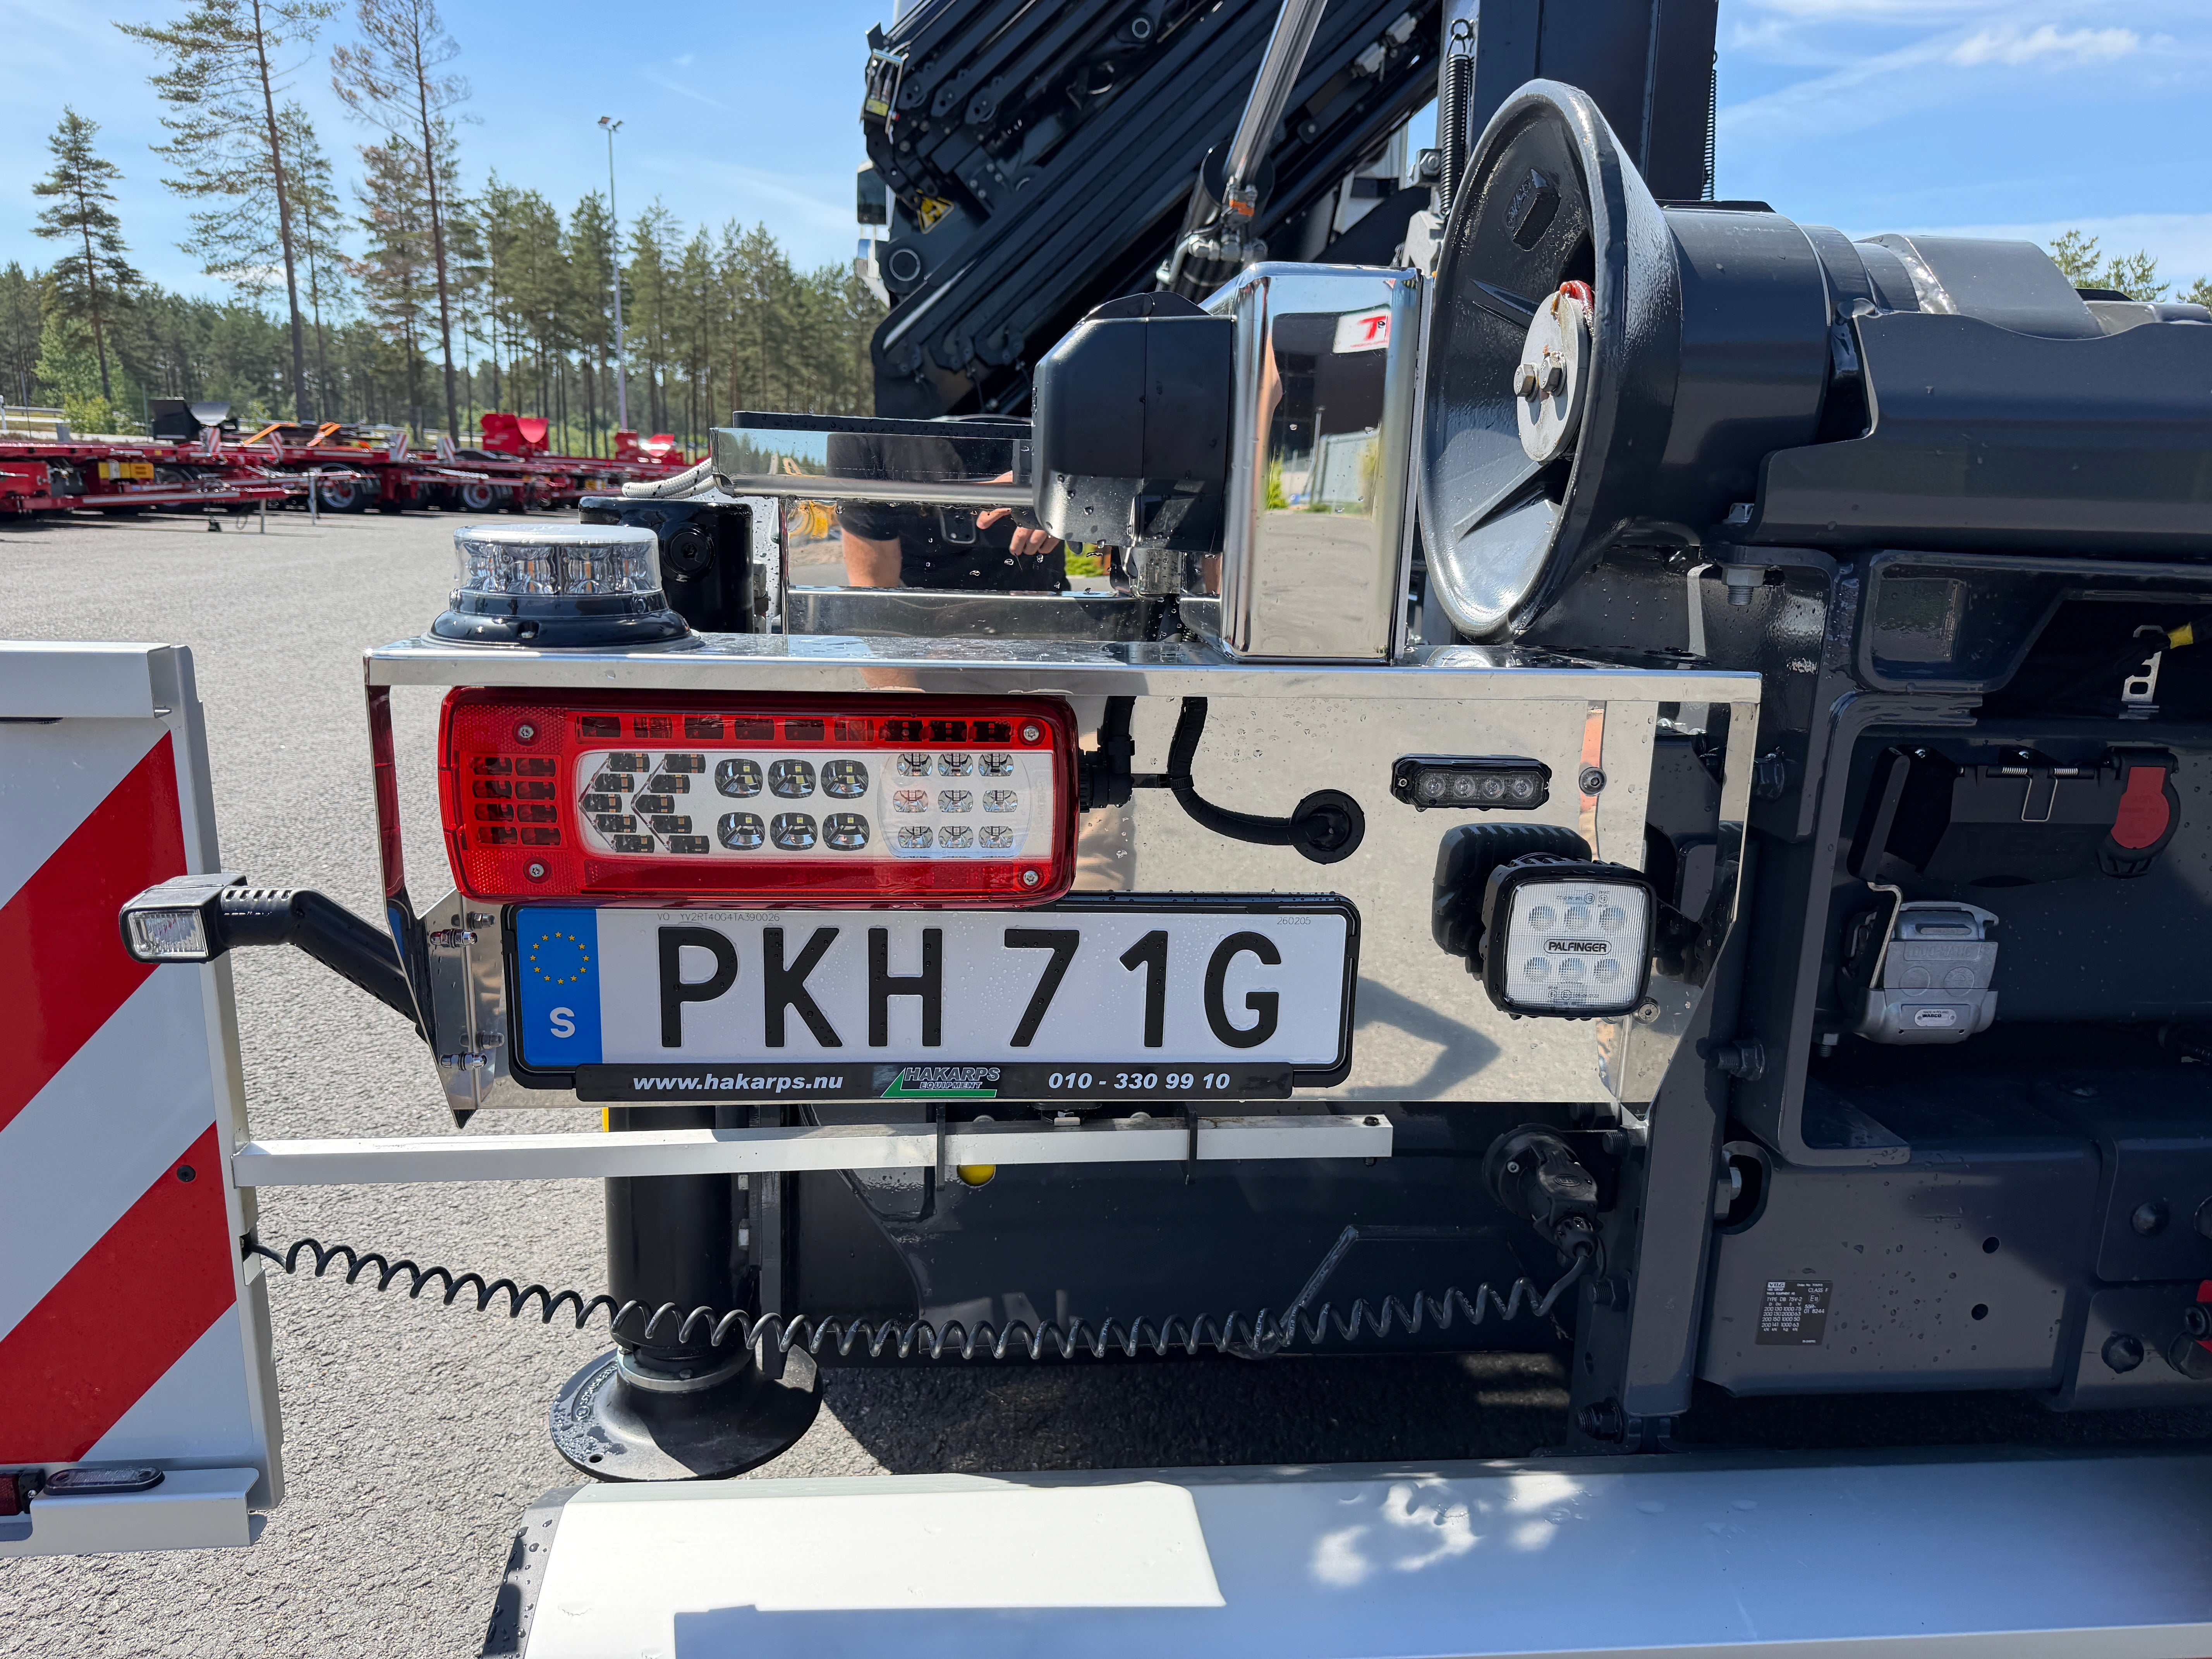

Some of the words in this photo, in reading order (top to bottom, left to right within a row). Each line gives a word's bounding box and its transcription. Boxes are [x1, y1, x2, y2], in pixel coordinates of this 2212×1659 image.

[657, 913, 670, 921] VO
[1277, 917, 1311, 925] 260205
[1548, 942, 1607, 952] PALFINGER
[1912, 945, 1973, 957] DUO-MATIC
[657, 926, 943, 1048] PKH
[1003, 929, 1282, 1048] 71G
[550, 1007, 575, 1038] S
[904, 1067, 1000, 1081] HAKARPS
[633, 1073, 843, 1093] www.hakarps.nu
[919, 1081, 983, 1089] EQUIPMENT
[1048, 1073, 1092, 1090] 010
[1114, 1072, 1158, 1090] 330
[1164, 1072, 1194, 1090] 99
[1204, 1072, 1230, 1090] 10
